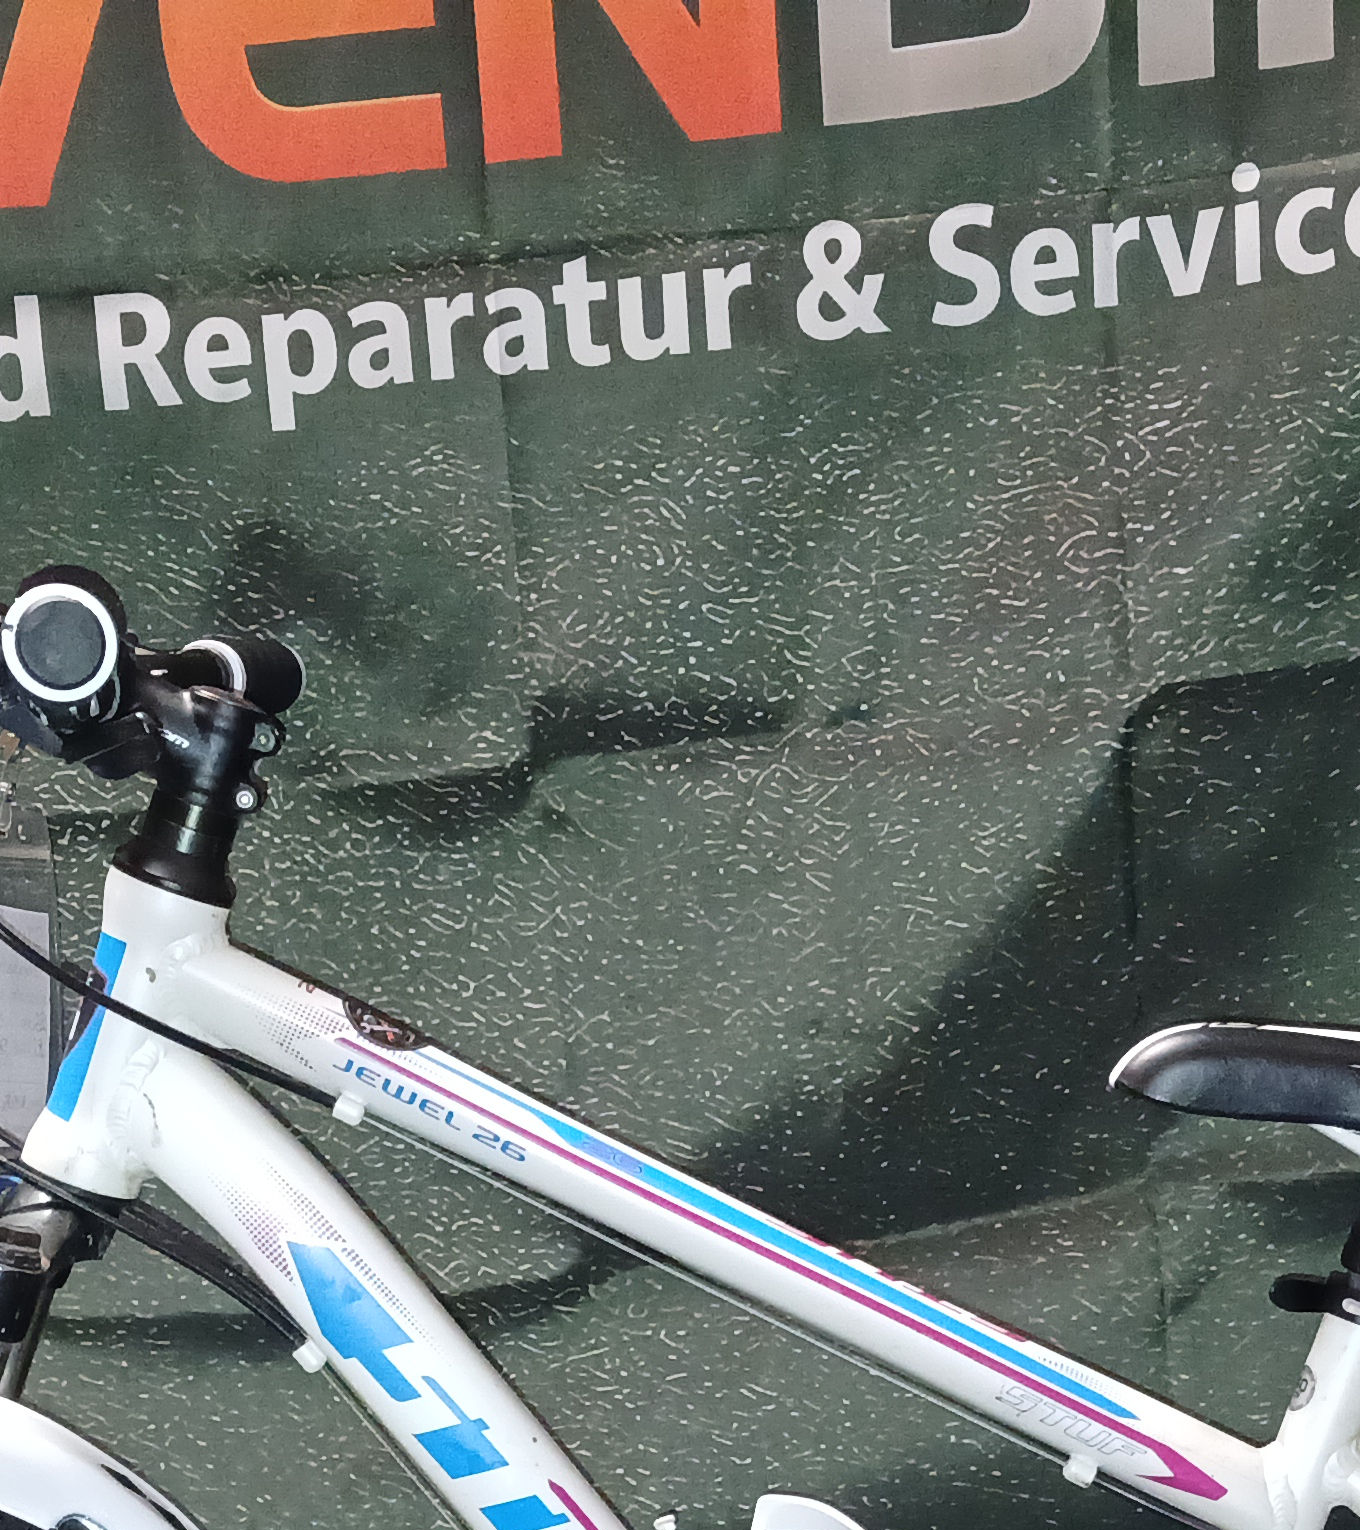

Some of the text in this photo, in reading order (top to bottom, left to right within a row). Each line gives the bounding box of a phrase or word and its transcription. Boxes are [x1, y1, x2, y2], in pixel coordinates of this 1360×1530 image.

[94, 256, 752, 432] Reparatur
[795, 219, 891, 342] &
[332, 1058, 461, 1131] JEWEL
[472, 1124, 527, 1162] 26
[995, 1385, 1147, 1457] STUF
